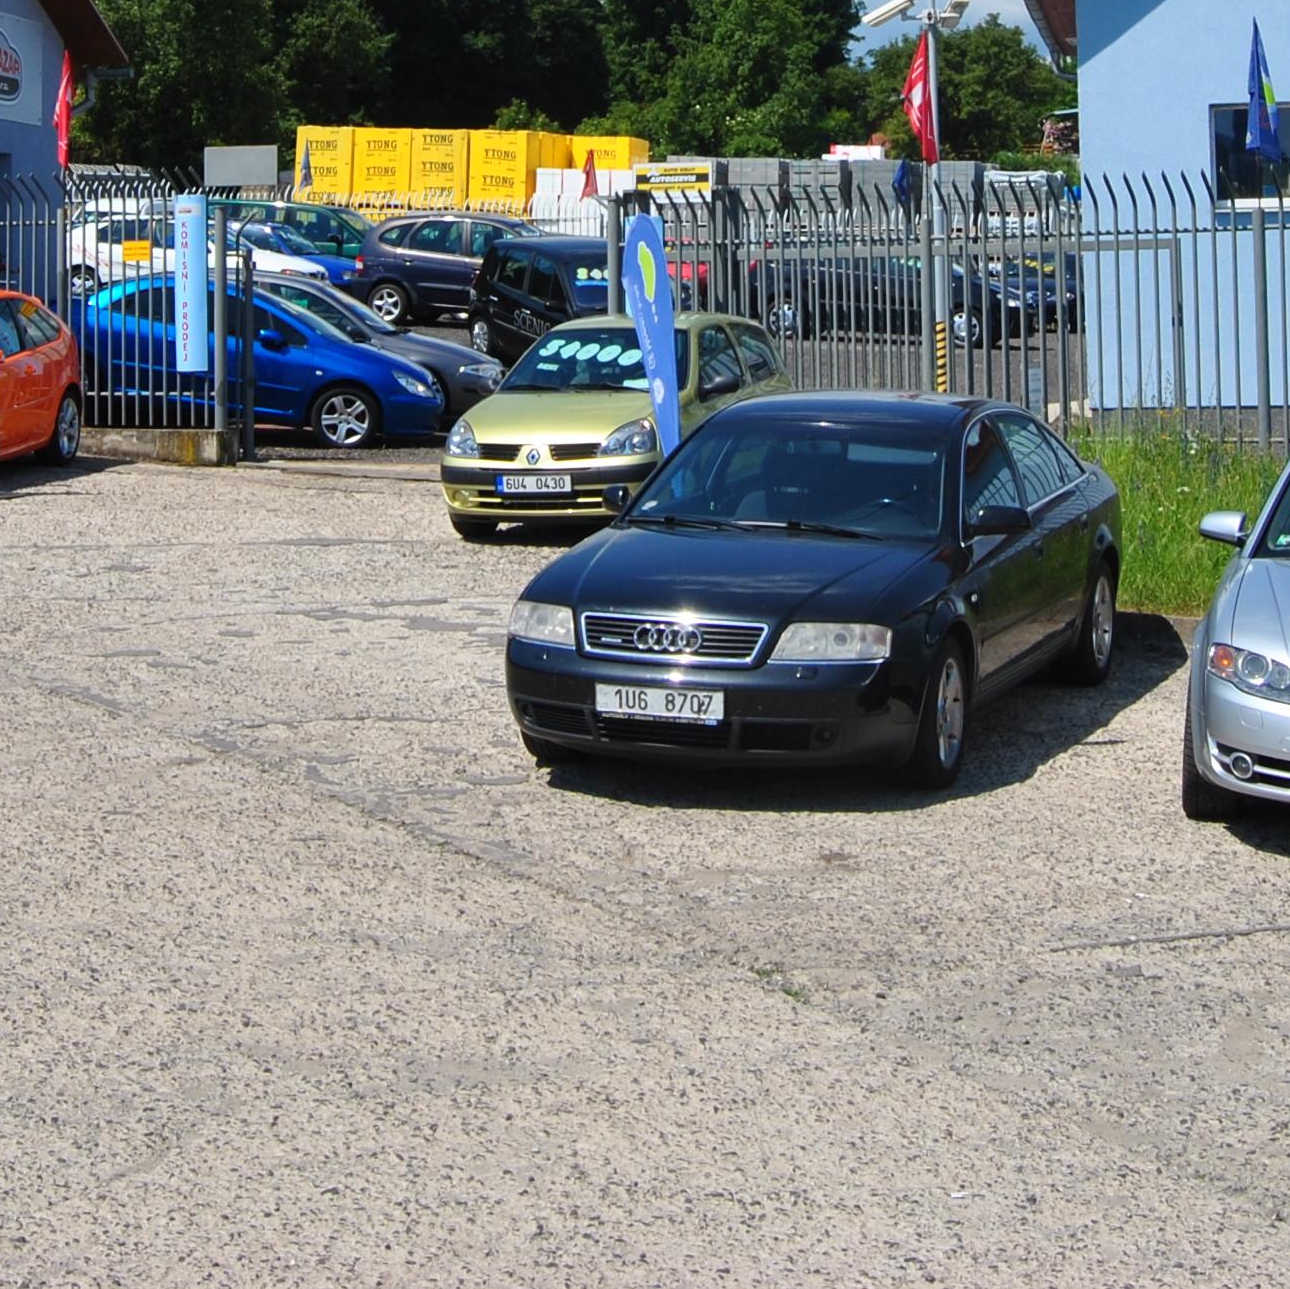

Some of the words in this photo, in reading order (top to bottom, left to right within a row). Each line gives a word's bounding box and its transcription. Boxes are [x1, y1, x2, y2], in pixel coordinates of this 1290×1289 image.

[422, 134, 453, 144] YTONG
[366, 140, 397, 149] YTONG
[484, 149, 516, 159] YTONG
[312, 166, 338, 175] TONG
[366, 166, 396, 176] YTONG
[422, 161, 453, 171] YTONG
[482, 175, 514, 187] YTONG
[506, 477, 527, 490] 6U4
[536, 477, 565, 490] 0430
[614, 688, 648, 710] 1U6
